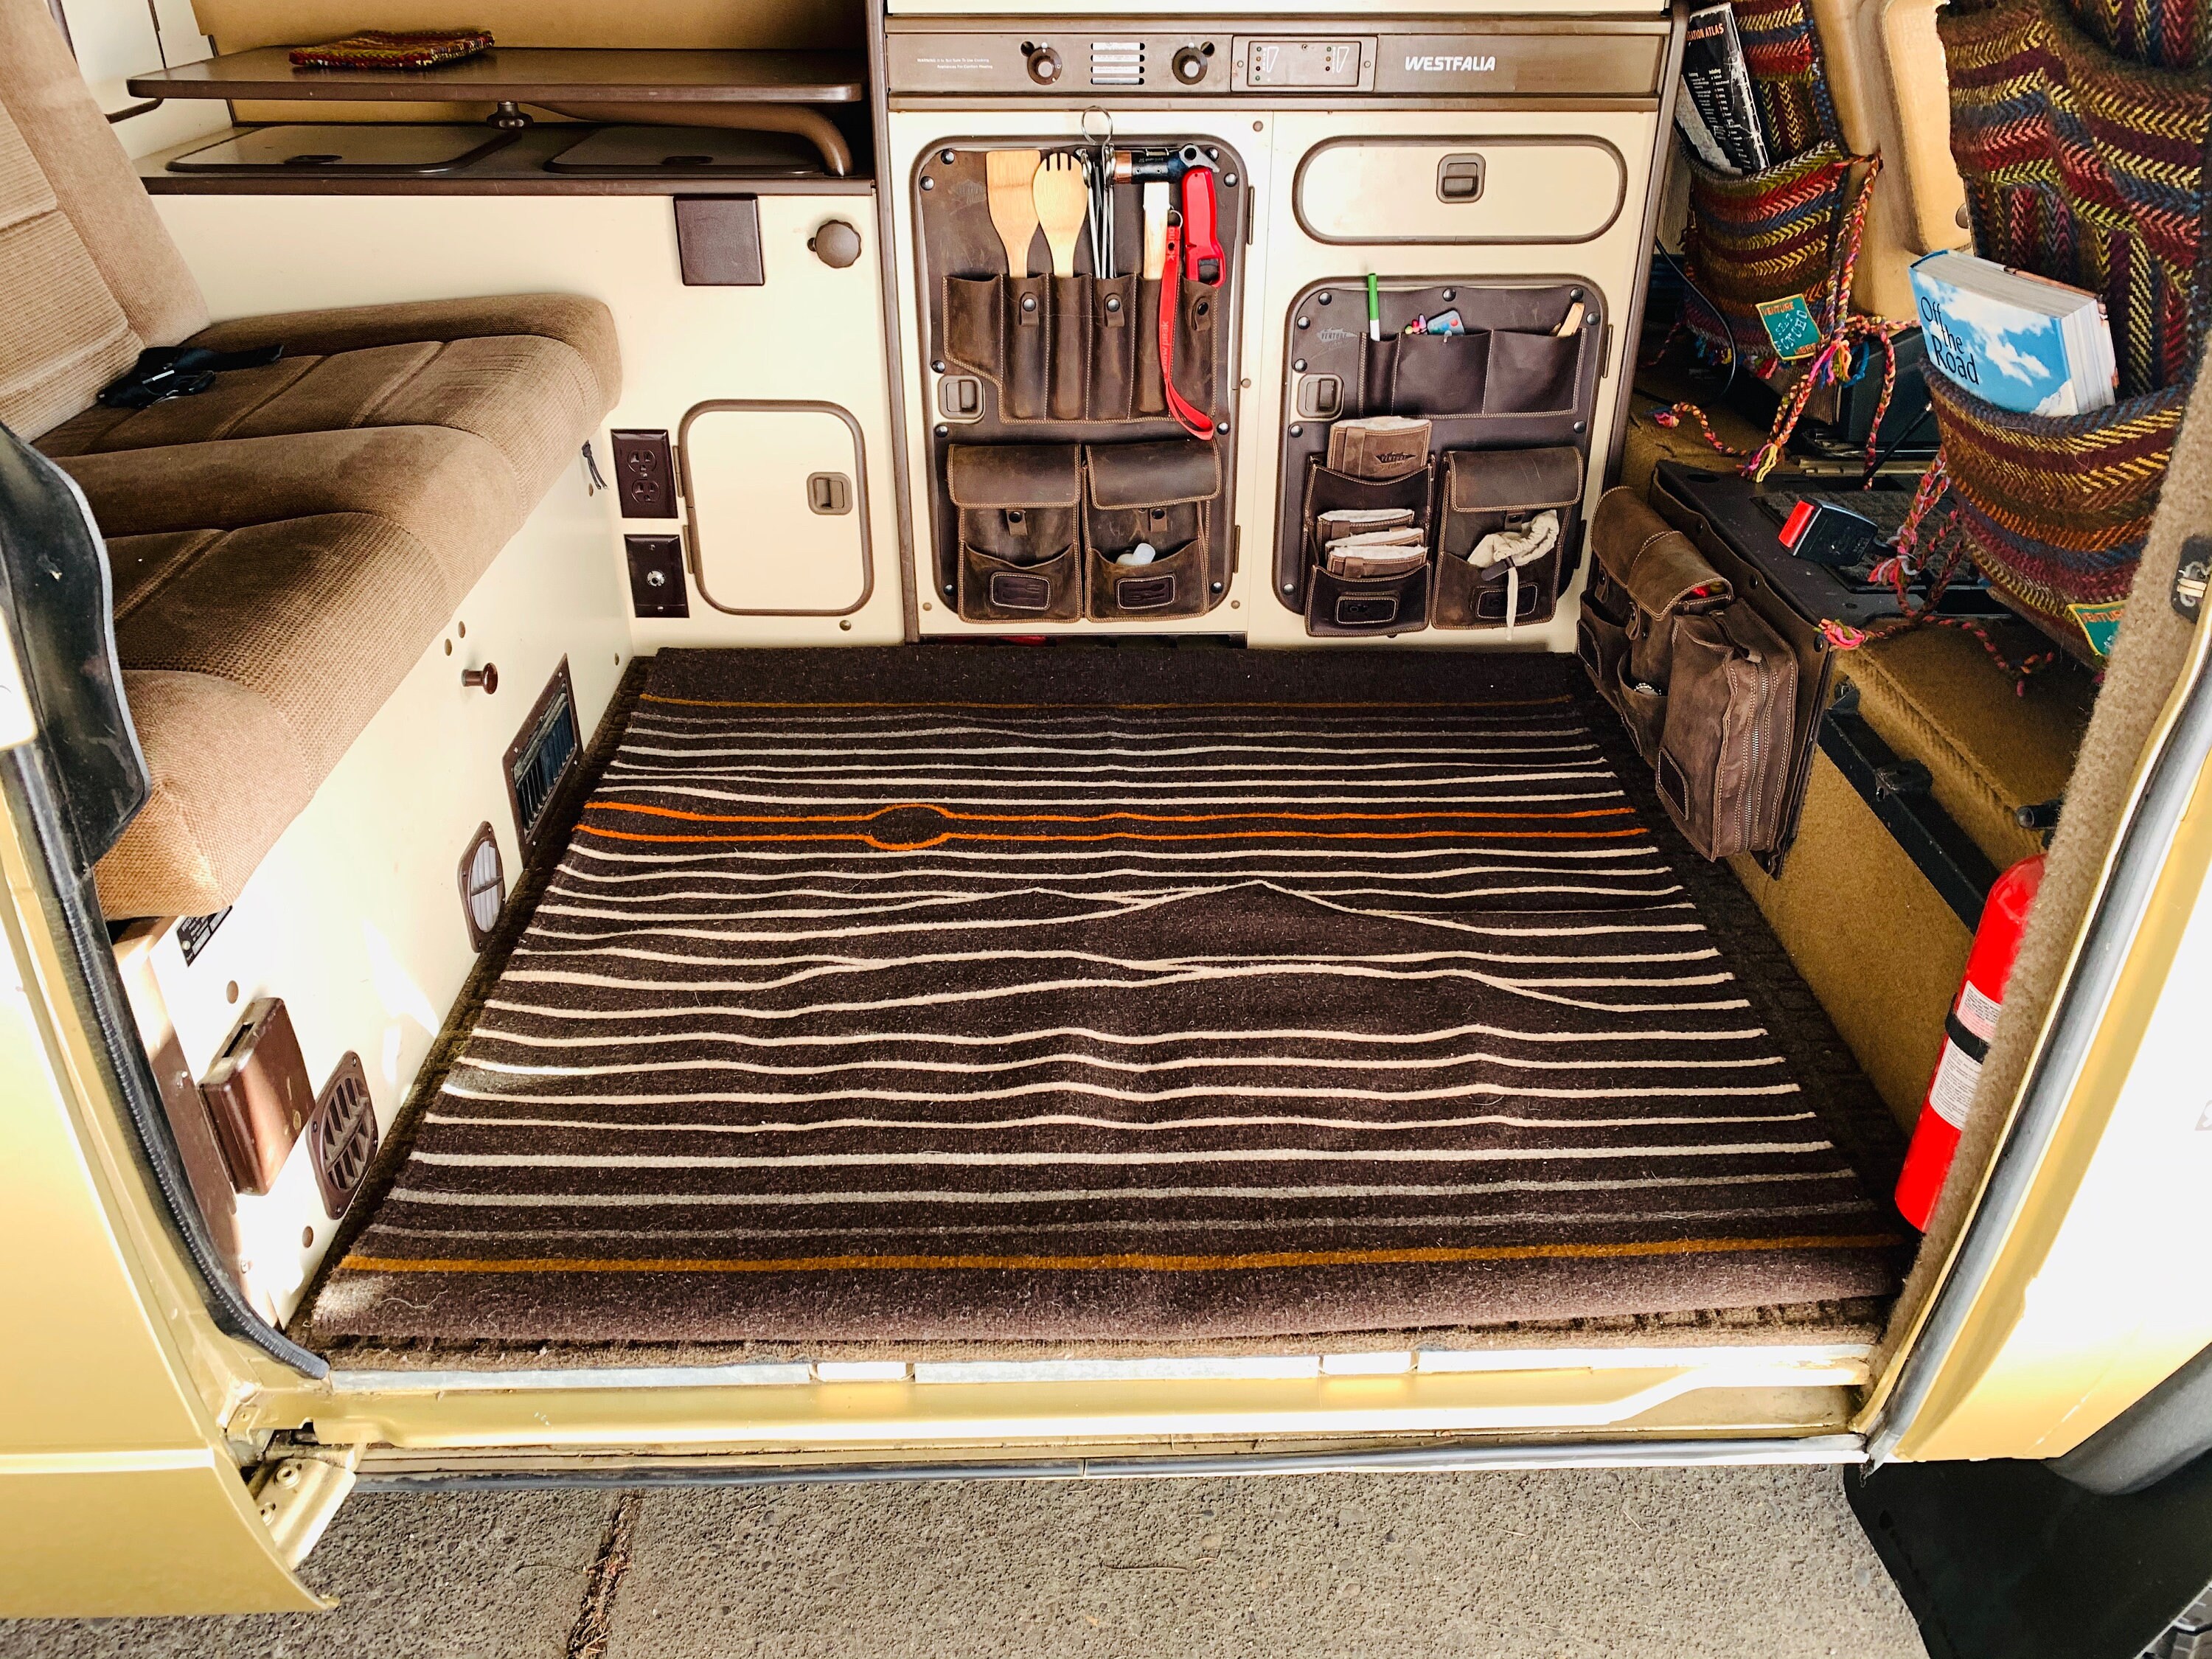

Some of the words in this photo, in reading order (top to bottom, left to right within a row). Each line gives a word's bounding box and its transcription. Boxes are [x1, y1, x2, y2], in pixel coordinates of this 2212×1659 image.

[1705, 23, 1724, 37] ATLAS
[1405, 56, 1496, 71] WESTFALIA
[1762, 302, 1795, 316] VENTURE
[1921, 296, 1942, 325] Off
[1941, 324, 1964, 354] the
[1931, 334, 1979, 385] Road
